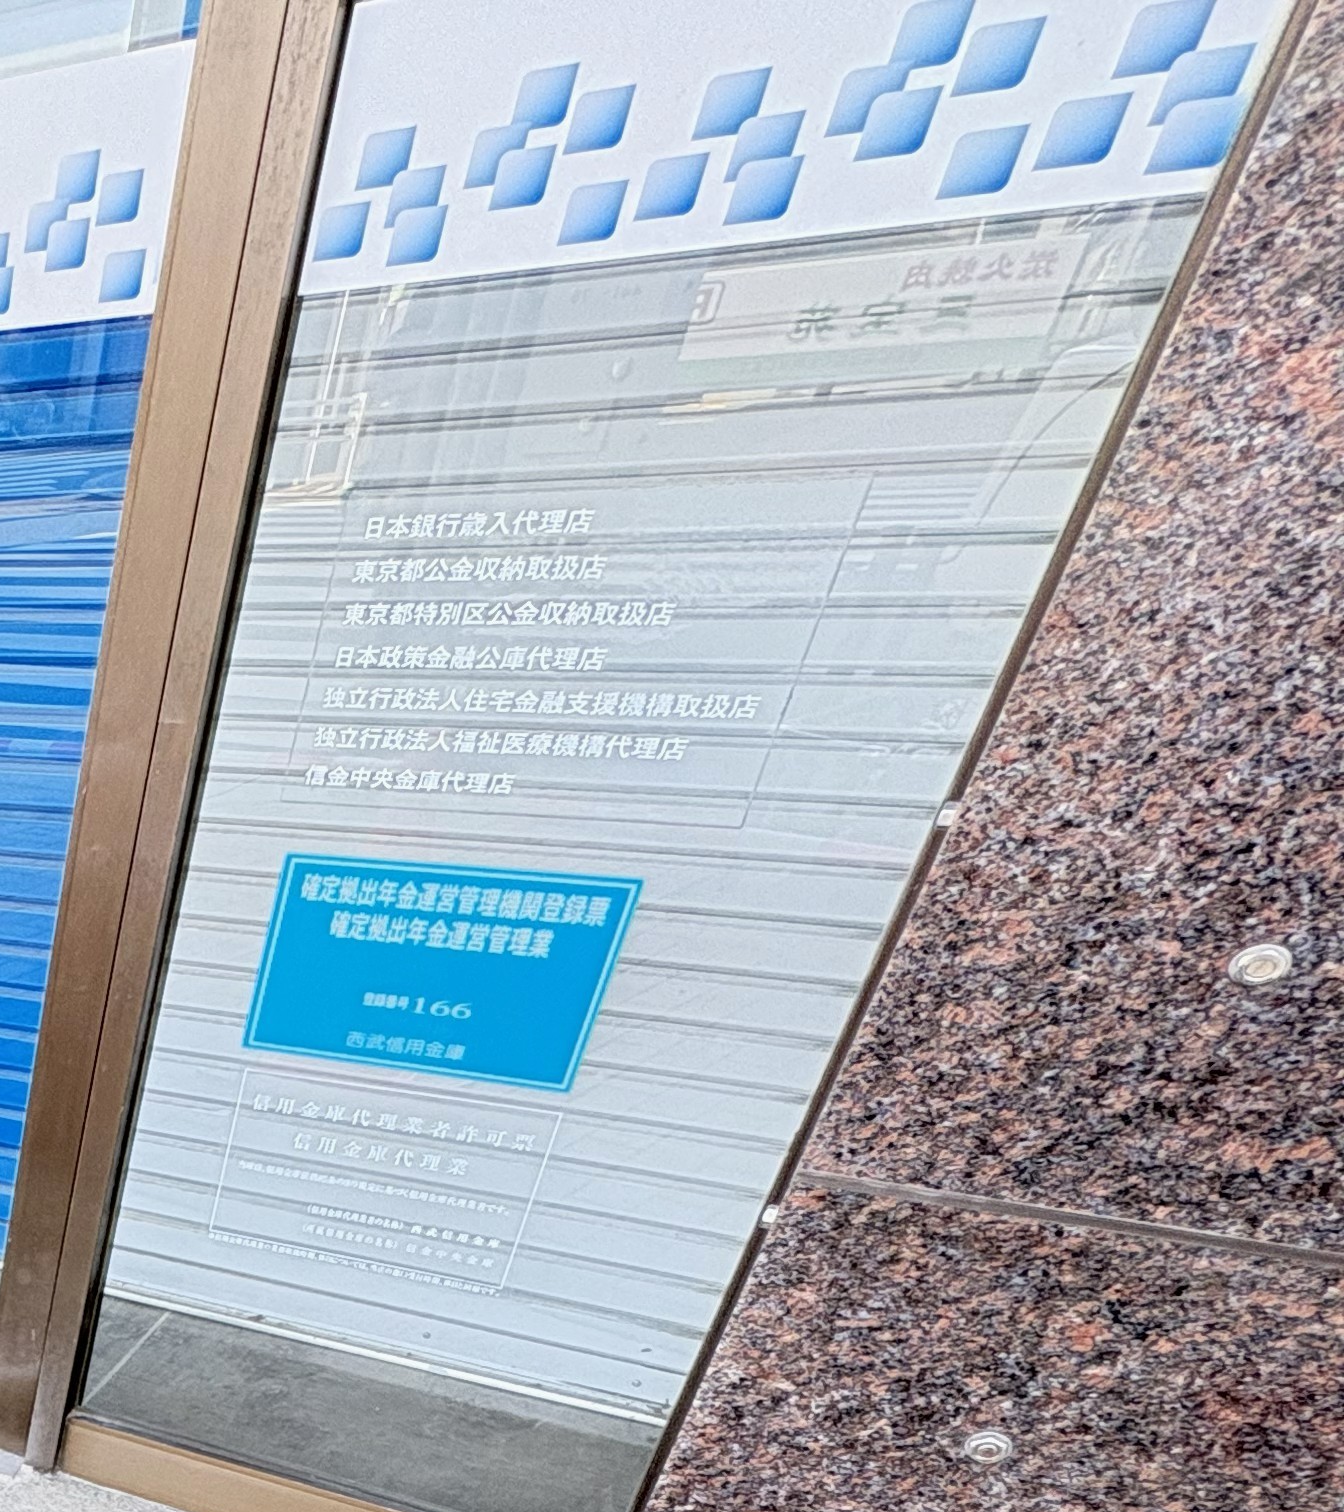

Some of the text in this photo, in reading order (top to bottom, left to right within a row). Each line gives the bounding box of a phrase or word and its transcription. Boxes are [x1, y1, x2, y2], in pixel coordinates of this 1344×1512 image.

[364, 507, 595, 540] 日本銀行歳入代理店
[351, 554, 607, 584] 東京都公金収納取扱店
[342, 601, 677, 627] 東京都特別区公金収納取扱店
[334, 645, 609, 671] 日本政策金融公庫代理店
[322, 687, 762, 719] 独立行政法人住宅金融支援機構取扱店
[313, 726, 690, 761] 独立行政法人福祉医療機構代理店
[304, 764, 516, 795] 信金中央金庫代理店
[413, 997, 473, 1020] 166
[345, 1031, 467, 1062] 西武信用金庫
[252, 1093, 537, 1153] 信用金庫代理業者許可票
[292, 1133, 469, 1176] 信用金庫代理業
